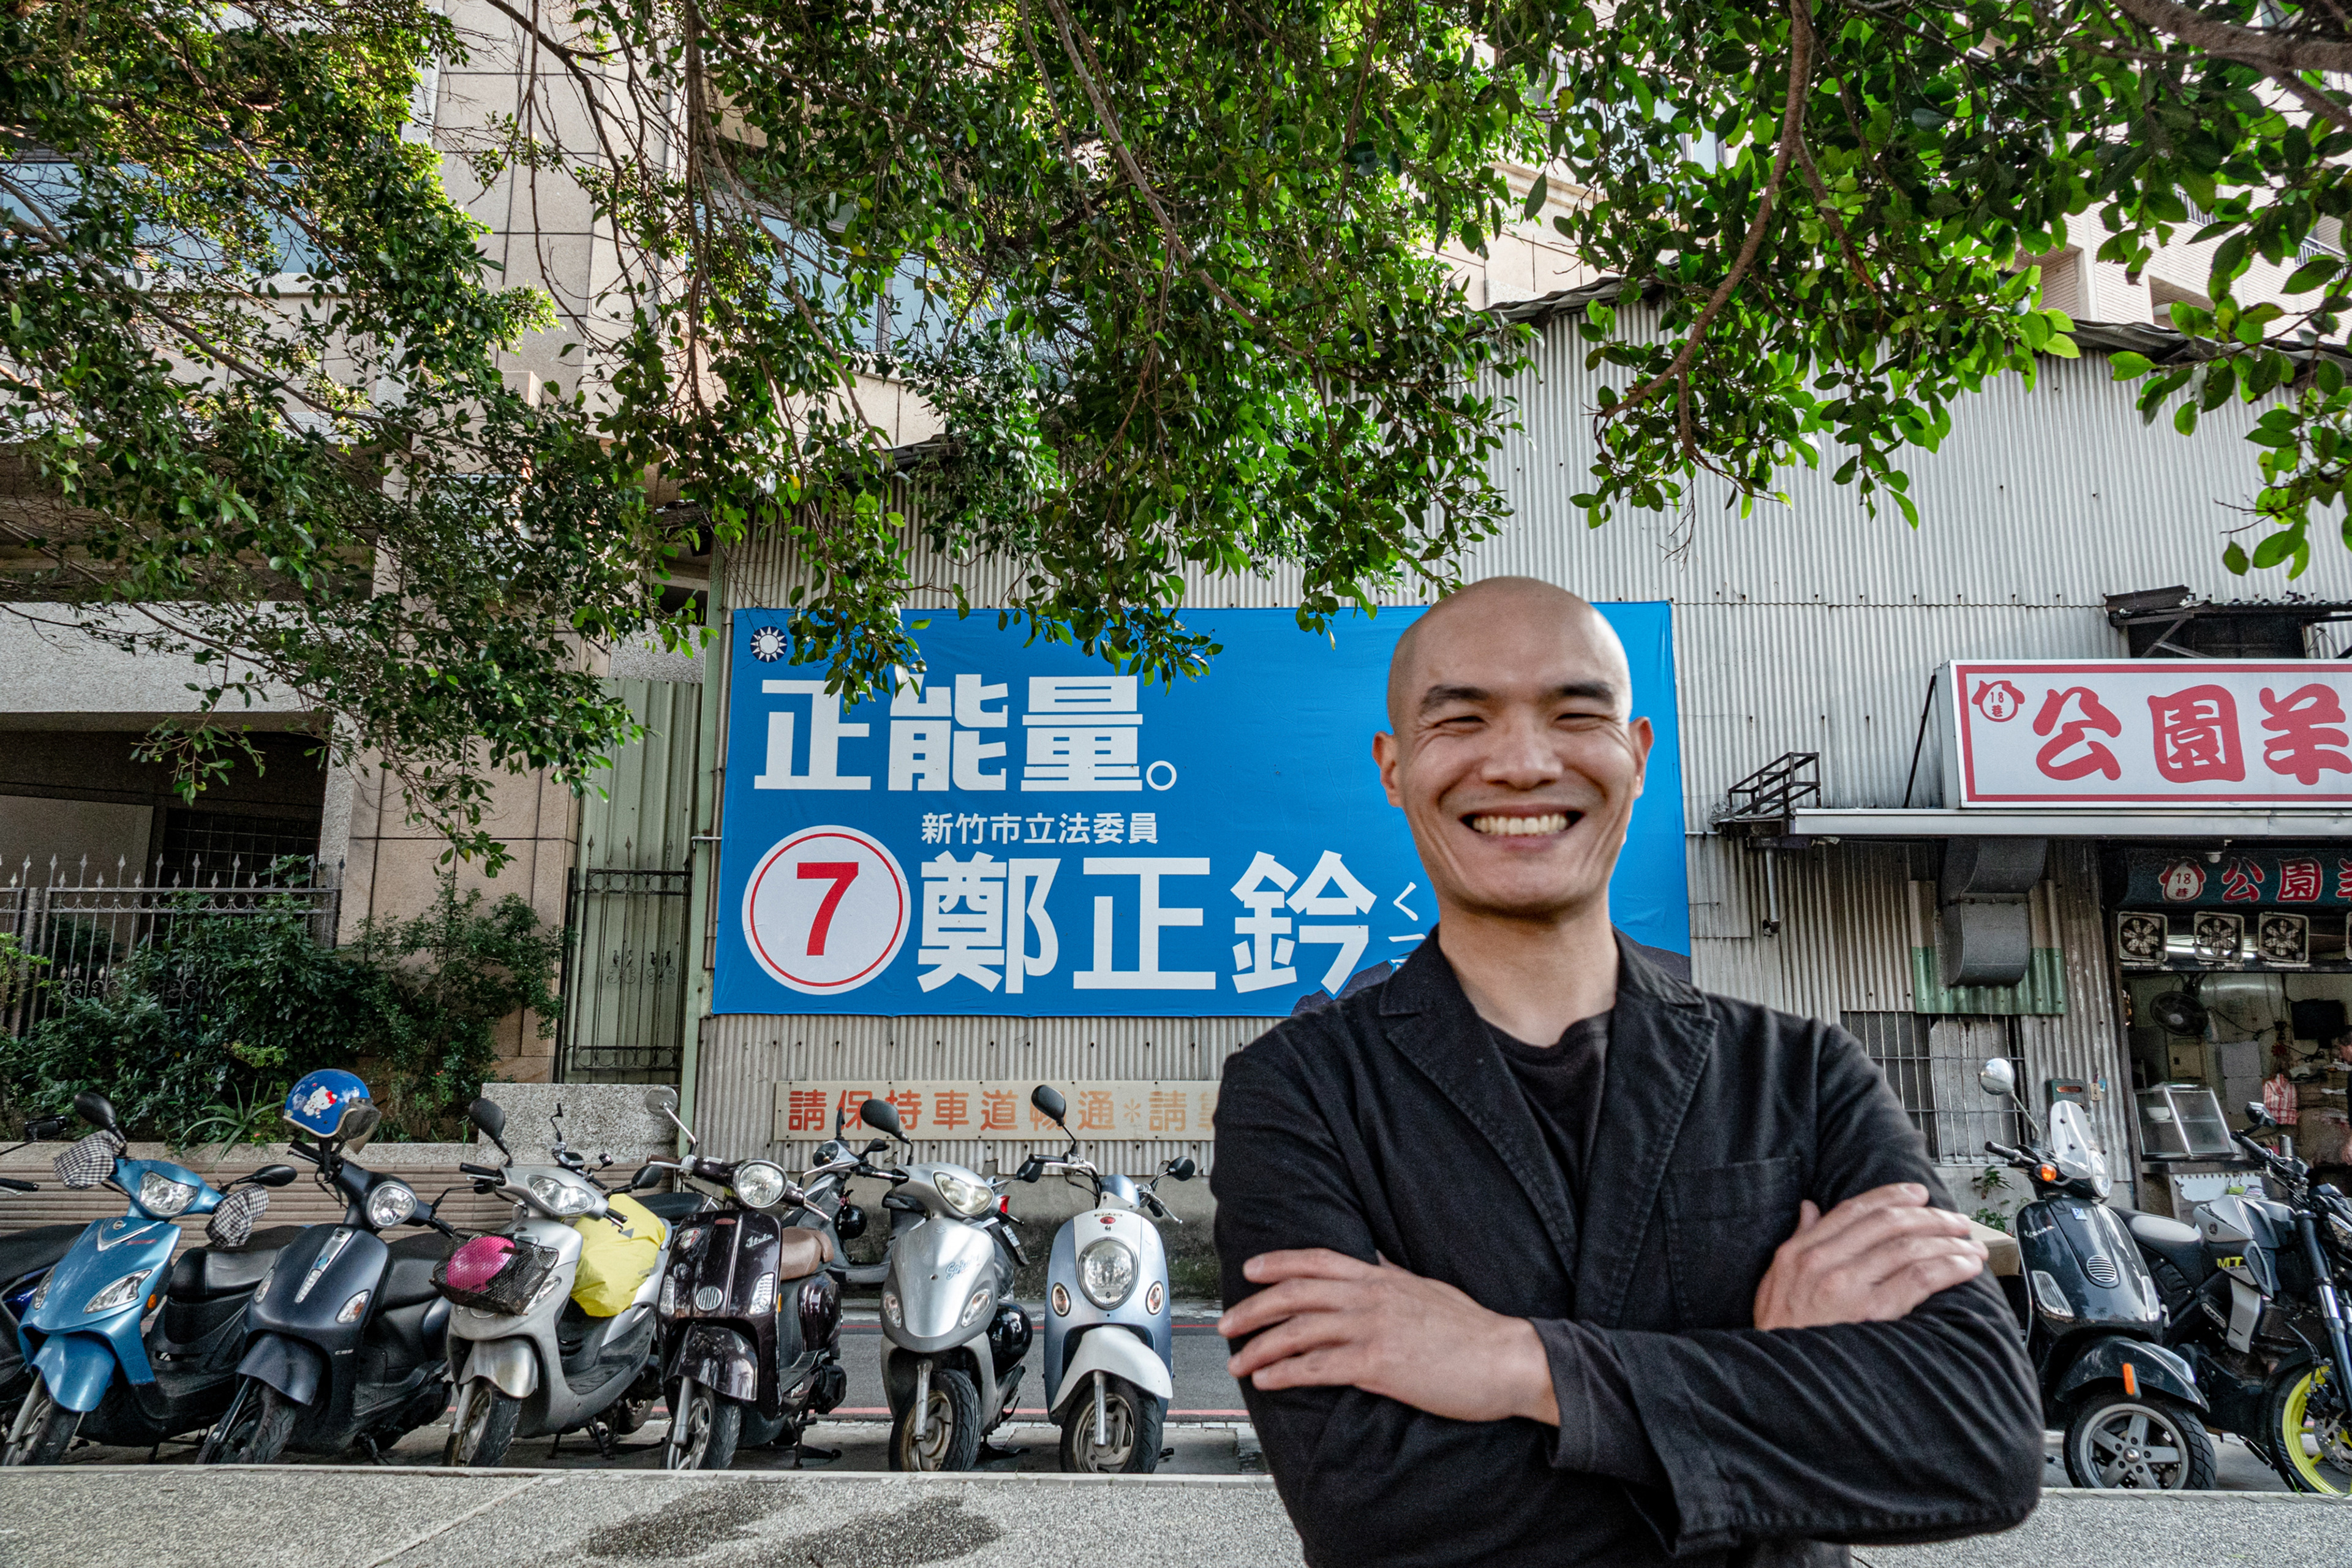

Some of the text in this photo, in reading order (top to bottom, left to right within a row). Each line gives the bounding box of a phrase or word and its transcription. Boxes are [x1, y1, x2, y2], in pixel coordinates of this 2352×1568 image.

[1990, 691, 2004, 704] 18
[2032, 683, 2352, 786] 公園羊
[921, 812, 1159, 845] 新竹市立法委員
[2176, 872, 2191, 884] 18
[796, 861, 859, 957] 7
[916, 850, 1378, 997] 鄭正鈐
[2217, 1256, 2244, 1268] MT
[790, 1381, 804, 1398] PGO
